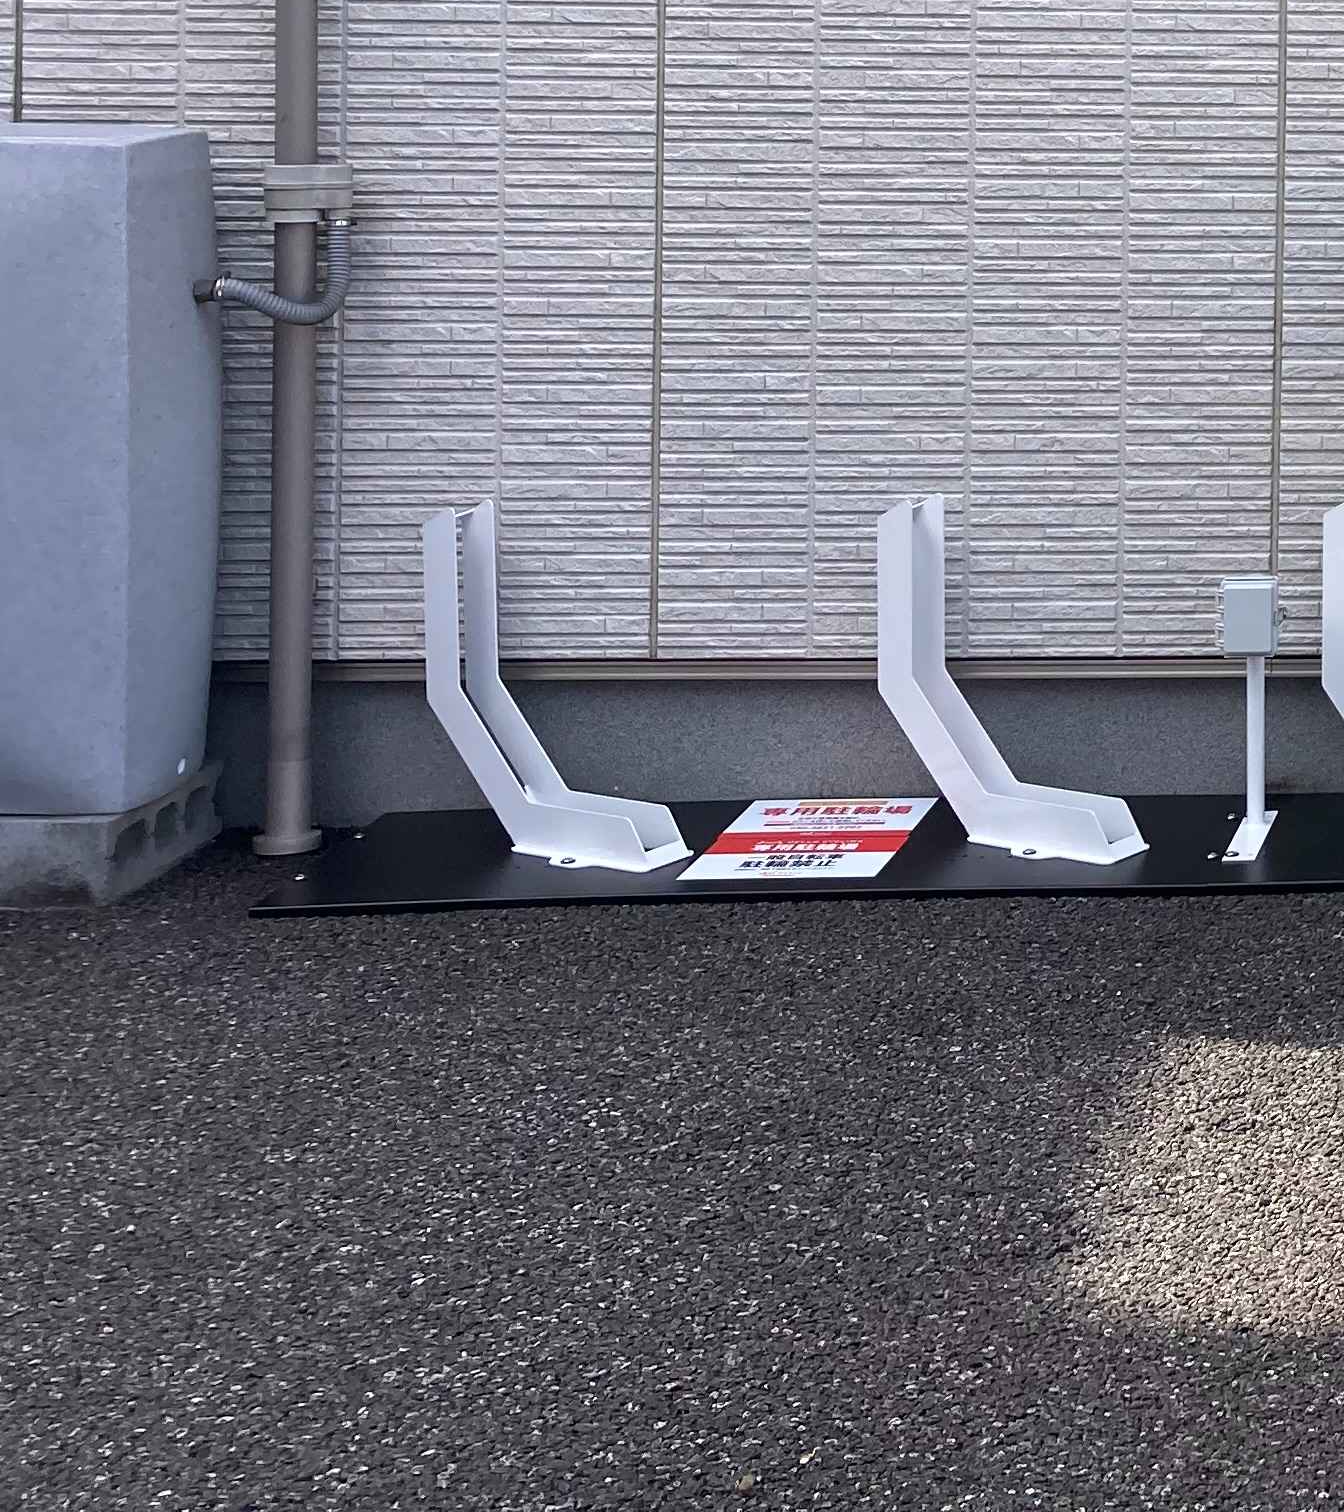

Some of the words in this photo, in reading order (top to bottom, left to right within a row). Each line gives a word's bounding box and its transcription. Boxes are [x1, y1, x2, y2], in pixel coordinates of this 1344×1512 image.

[760, 805, 913, 816] 専用駐輪場
[739, 860, 837, 868] 駐輪禁止
